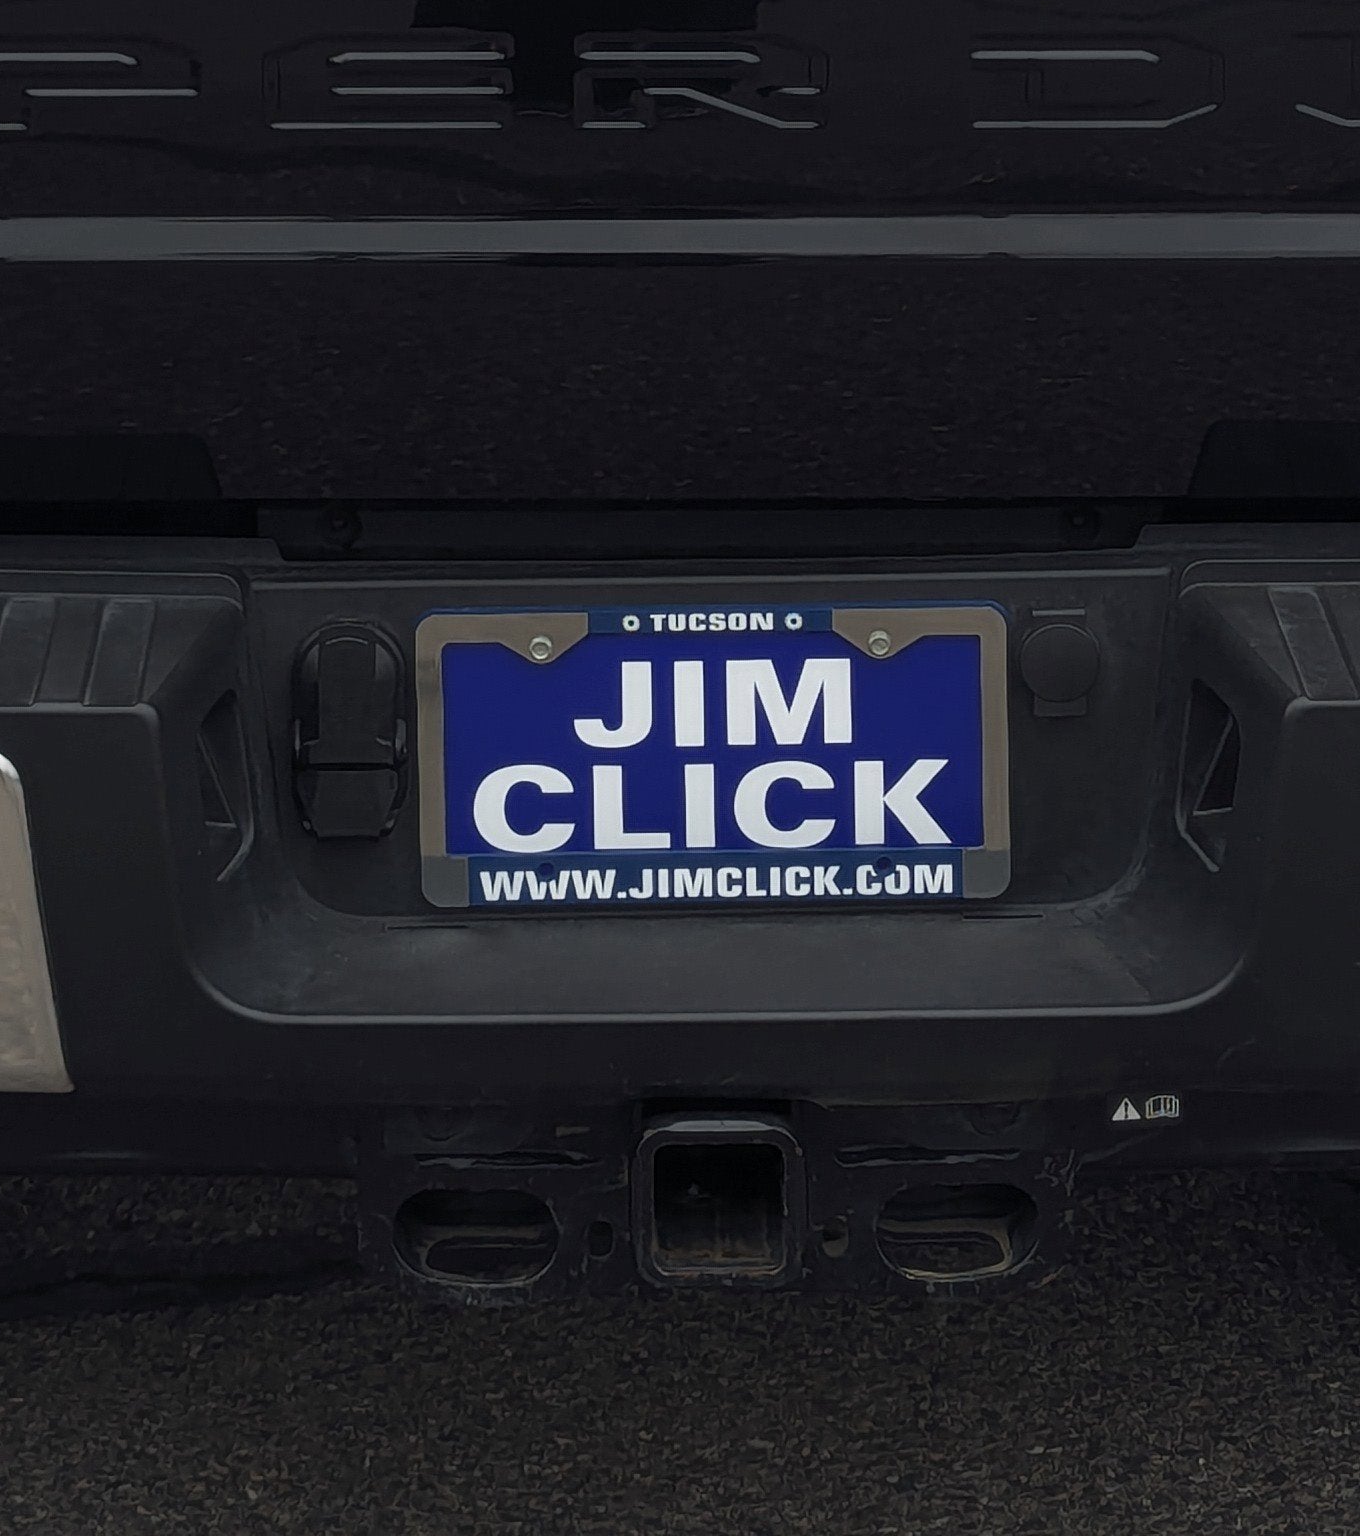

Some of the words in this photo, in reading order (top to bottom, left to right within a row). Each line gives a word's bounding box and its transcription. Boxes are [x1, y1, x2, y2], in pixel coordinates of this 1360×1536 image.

[649, 611, 774, 632] TUCSON
[573, 658, 853, 749] JIM
[473, 758, 952, 854] CLICK
[479, 864, 953, 902] WWW.JIMCLICK.COM
